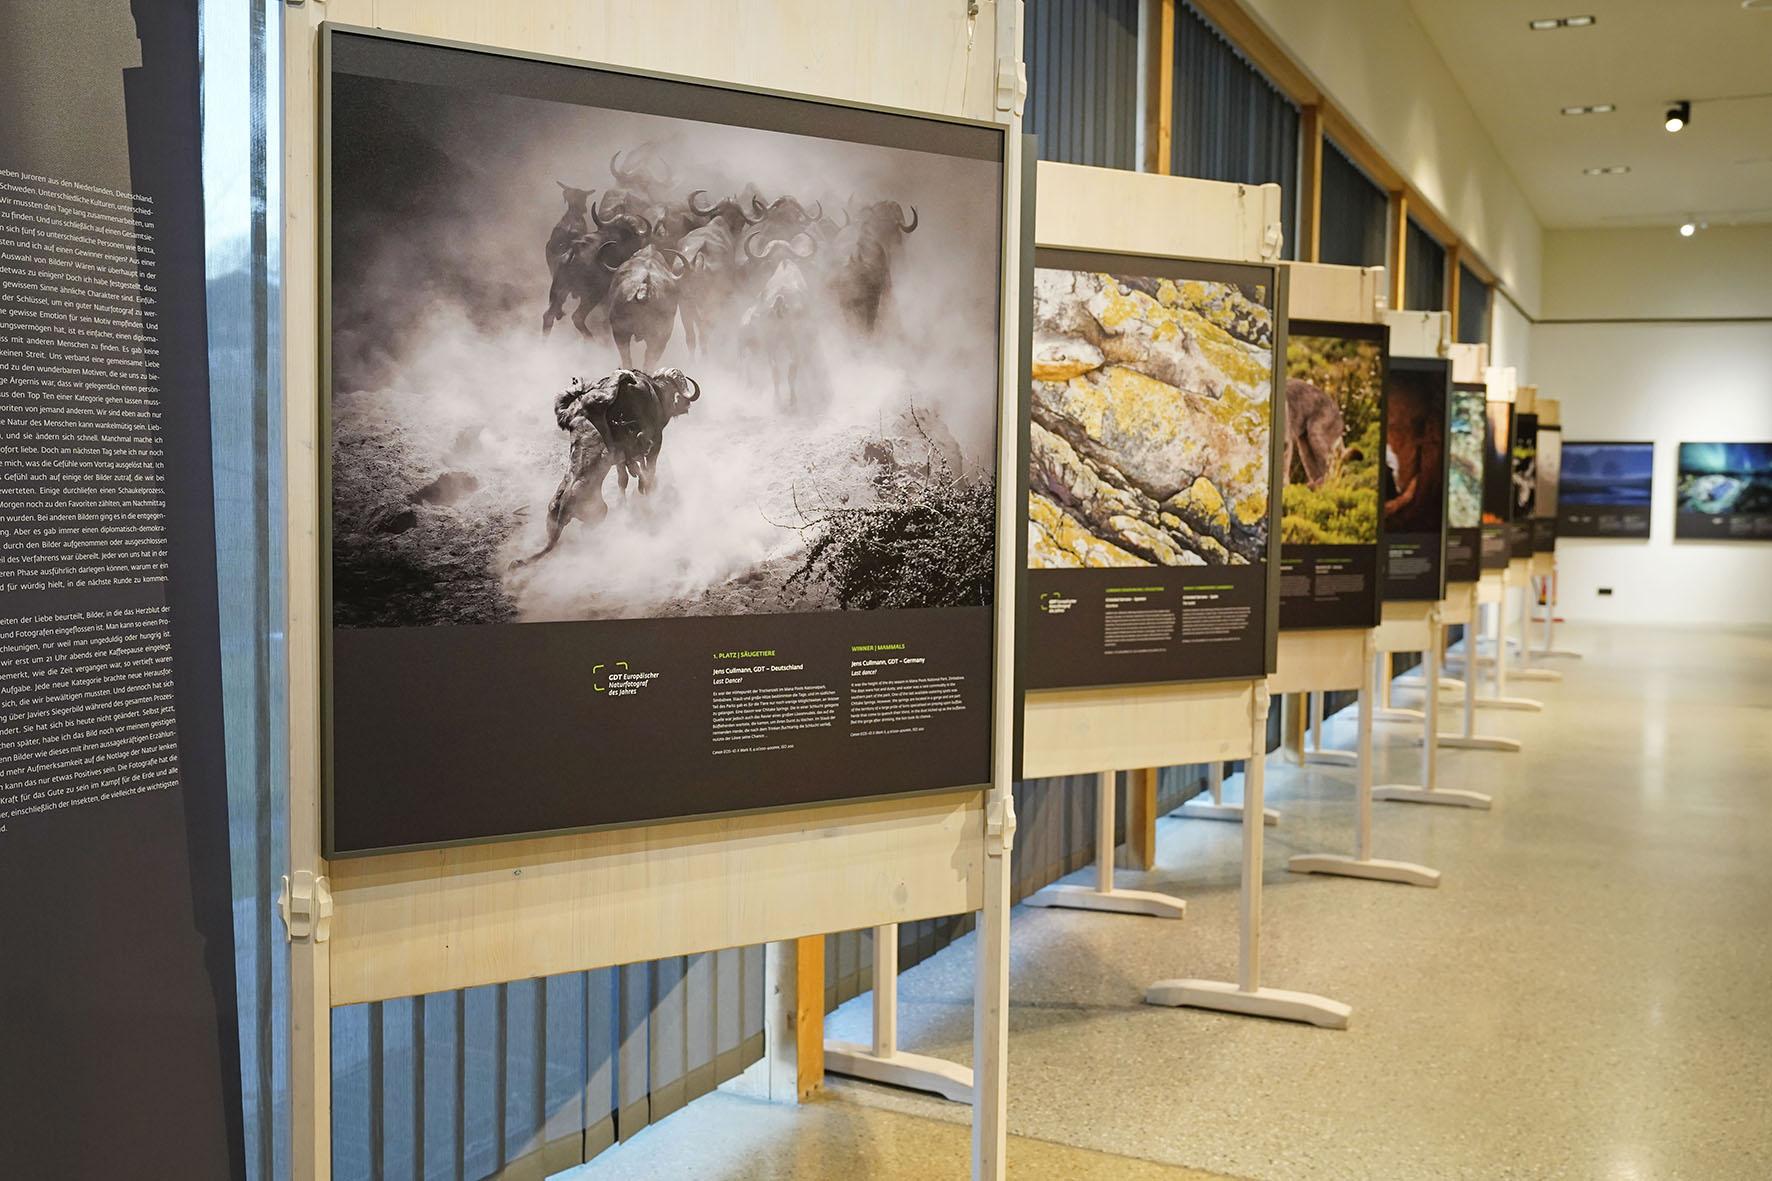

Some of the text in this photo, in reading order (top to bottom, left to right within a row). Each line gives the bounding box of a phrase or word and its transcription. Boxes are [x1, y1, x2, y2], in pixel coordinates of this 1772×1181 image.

[21, 172, 46, 183] Juroren
[38, 188, 89, 204] Unterschiedliche
[13, 200, 56, 211] mussten drei
[36, 215, 50, 224] Und
[6, 225, 20, 233] sich
[22, 226, 36, 238] fünf
[32, 242, 42, 250] ich
[44, 245, 55, 254] auf
[1, 251, 32, 262] Auswahl
[49, 257, 73, 267] Bildern?
[38, 271, 64, 281] einigen?
[3, 281, 58, 293] gewissem Sinne
[2, 293, 15, 301] der
[9, 309, 67, 320] gewisse Emotion
[54, 326, 66, 334] hat,
[26, 337, 54, 346] anderen
[22, 363, 35, 371] den
[37, 365, 80, 374] wunderbaren
[27, 391, 40, 401] Top
[39, 406, 64, 415] jemand
[7, 418, 28, 426] Natur
[44, 419, 77, 428] Menschen
[49, 473, 60, 482] auf
[40, 487, 97, 496] Einige durchliefen
[43, 526, 56, 536] gab
[21, 554, 59, 563] Verfahrens
[7, 583, 18, 593] für
[35, 614, 53, 622] Liebe
[16, 625, 95, 638] Fotografen eingeflossen
[57, 639, 71, 647] weil
[35, 681, 50, 692] Jede
[609, 680, 648, 688] Naturfotograf
[9, 710, 50, 721] über Javiers
[50, 720, 64, 729] sich
[43, 734, 60, 743] habe
[13, 753, 34, 761] Bilder
[6, 757, 83, 776] mehr Aufmerksamkeit
[1, 795, 18, 804] Kraft
[21, 793, 31, 803] für
